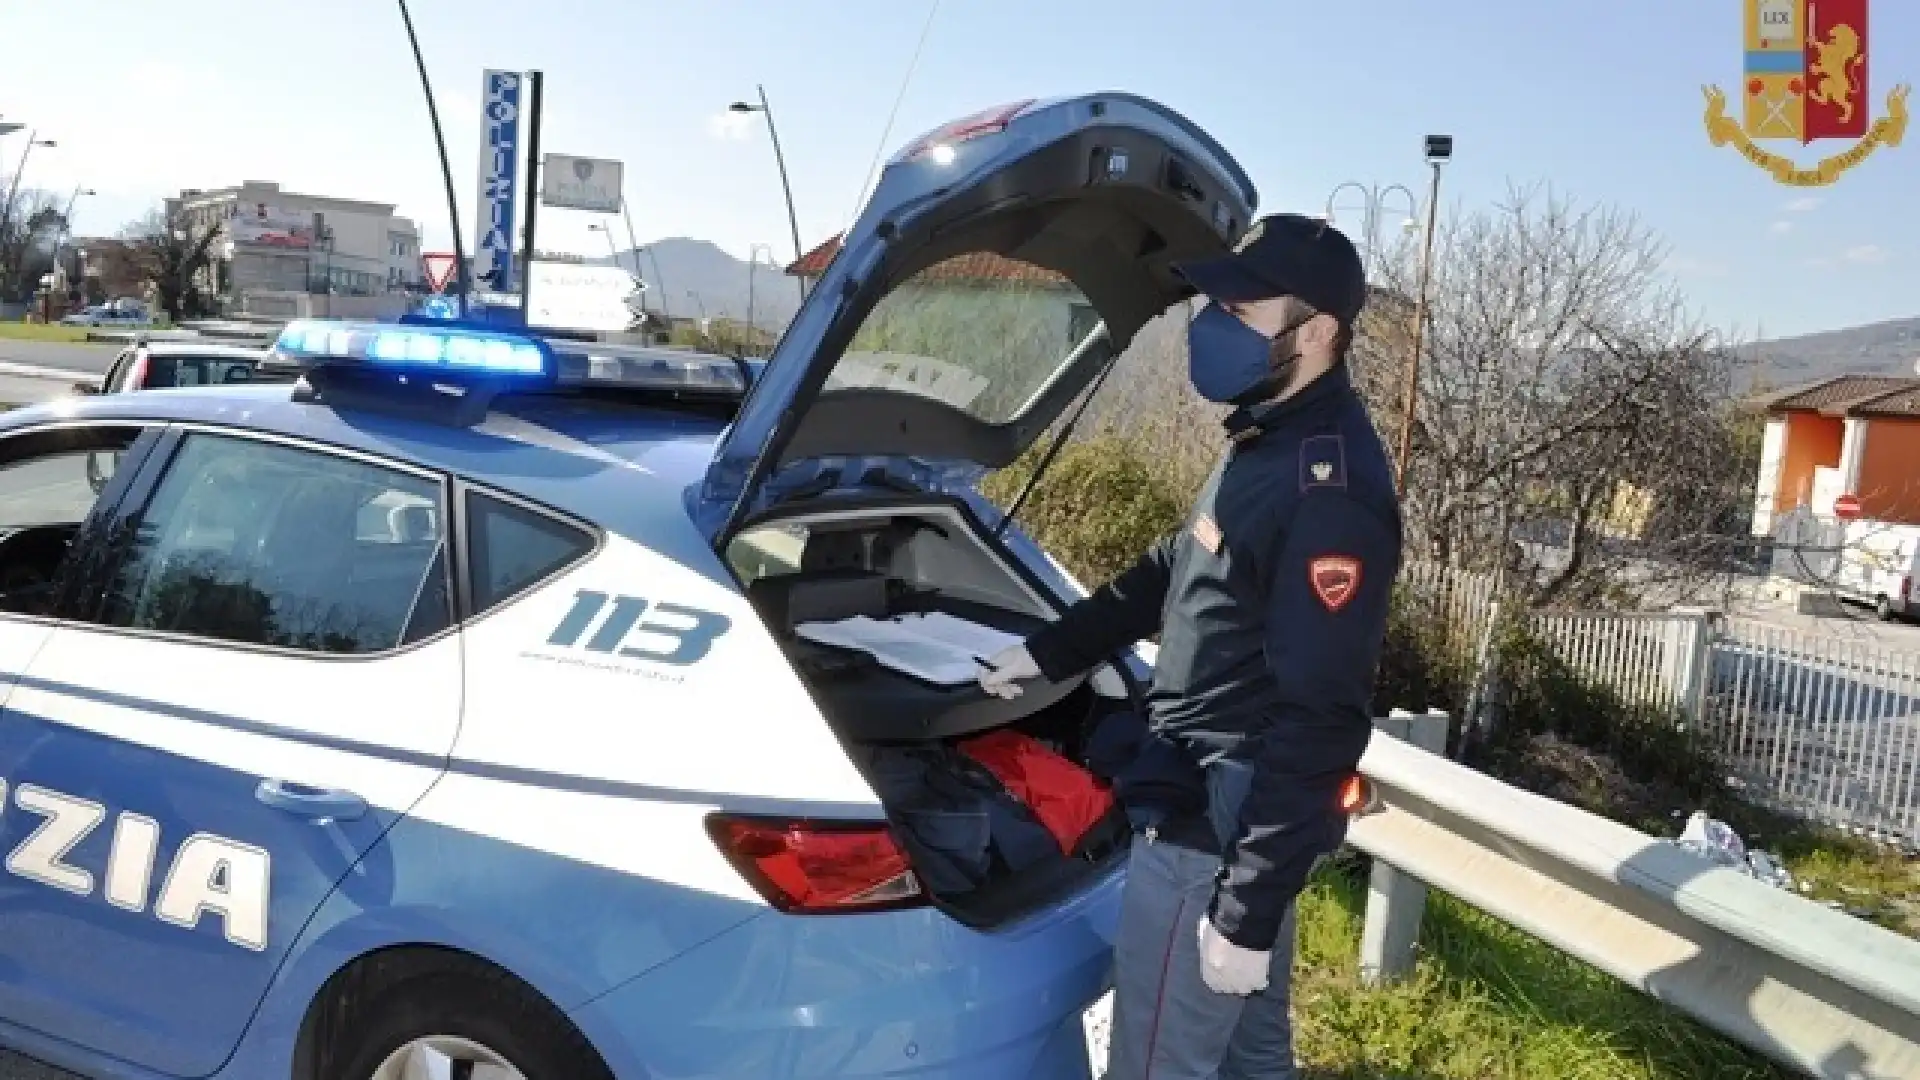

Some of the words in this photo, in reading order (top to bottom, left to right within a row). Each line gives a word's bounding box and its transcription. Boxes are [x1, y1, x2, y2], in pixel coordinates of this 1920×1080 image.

[482, 72, 519, 250] POLIZIA
[546, 588, 732, 666] 113
[0, 776, 271, 951] ZIA
